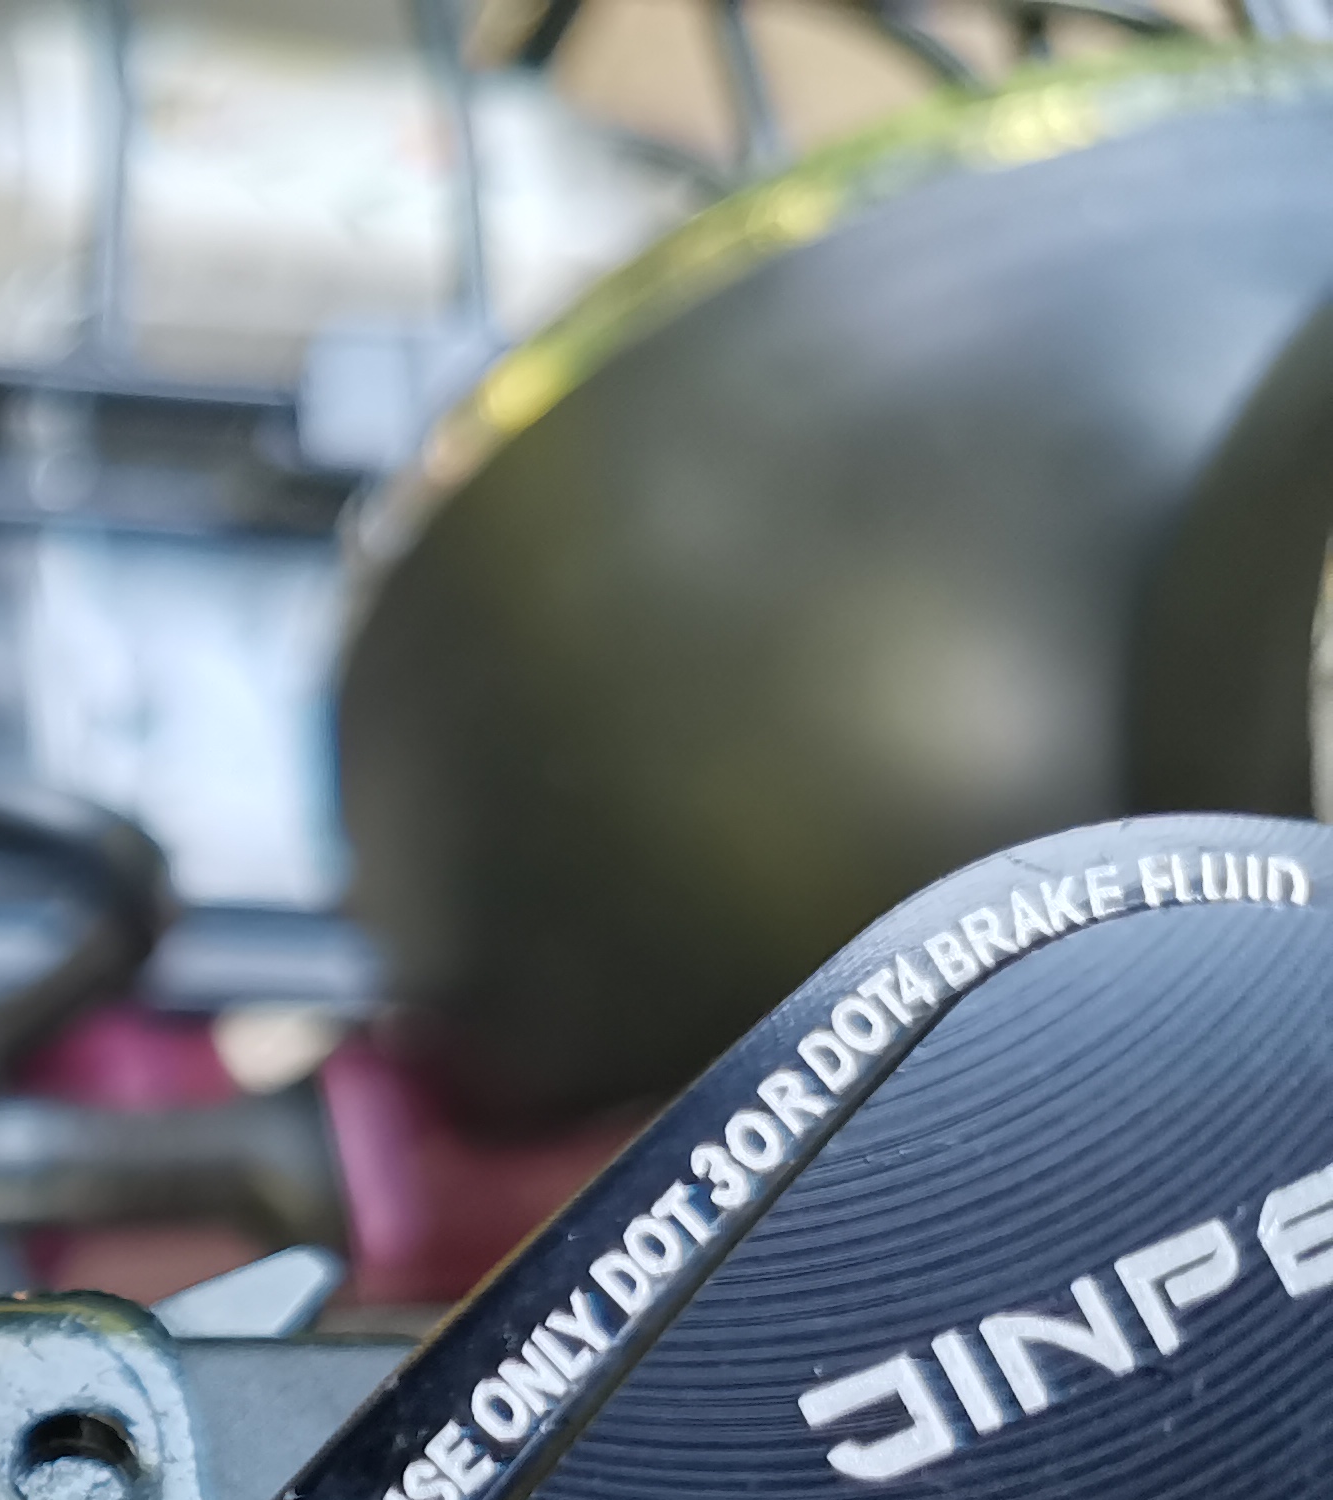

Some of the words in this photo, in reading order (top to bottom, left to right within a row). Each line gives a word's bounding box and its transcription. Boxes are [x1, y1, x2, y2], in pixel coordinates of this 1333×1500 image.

[471, 1286, 613, 1443] ONLY
[589, 1179, 715, 1315] DOT
[923, 865, 1125, 991] BRAKE
[1138, 852, 1312, 908] FLUID
[798, 1163, 1333, 1480] JINPE
